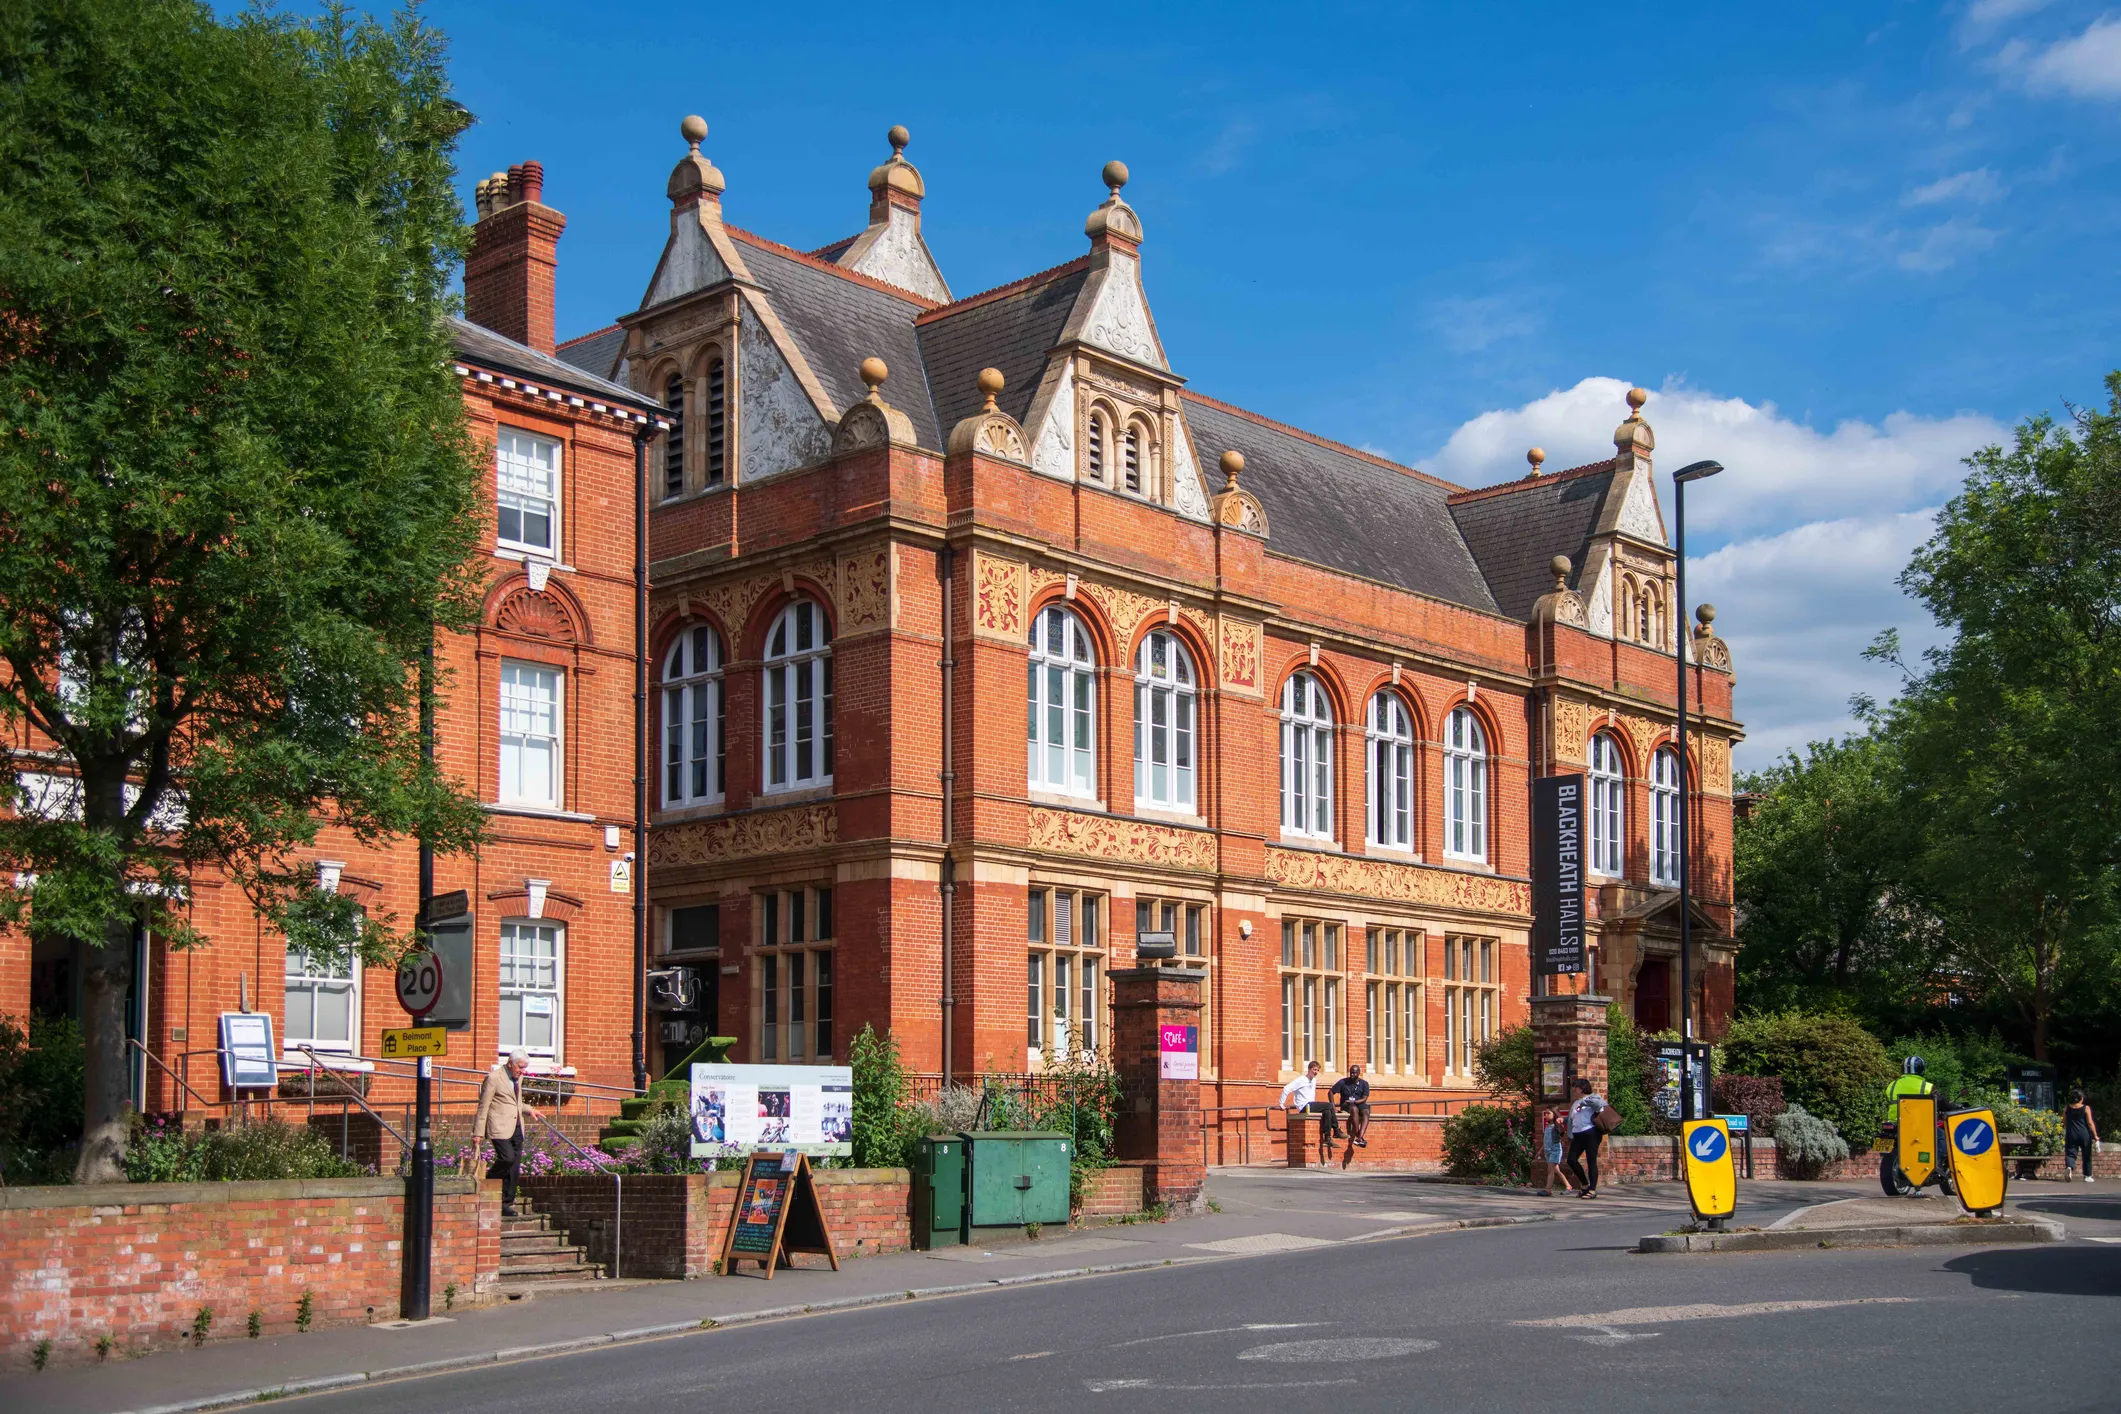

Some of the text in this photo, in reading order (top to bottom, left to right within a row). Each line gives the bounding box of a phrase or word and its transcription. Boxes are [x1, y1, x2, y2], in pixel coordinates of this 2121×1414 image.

[1558, 784, 1578, 946] BLACKHEATH HALLS
[403, 966, 436, 996] 20
[402, 1032, 432, 1041] Belmont
[407, 1044, 427, 1053] Place
[922, 1145, 926, 1153] 8
[943, 1145, 948, 1154] 8
[1060, 1143, 1066, 1152] 8
